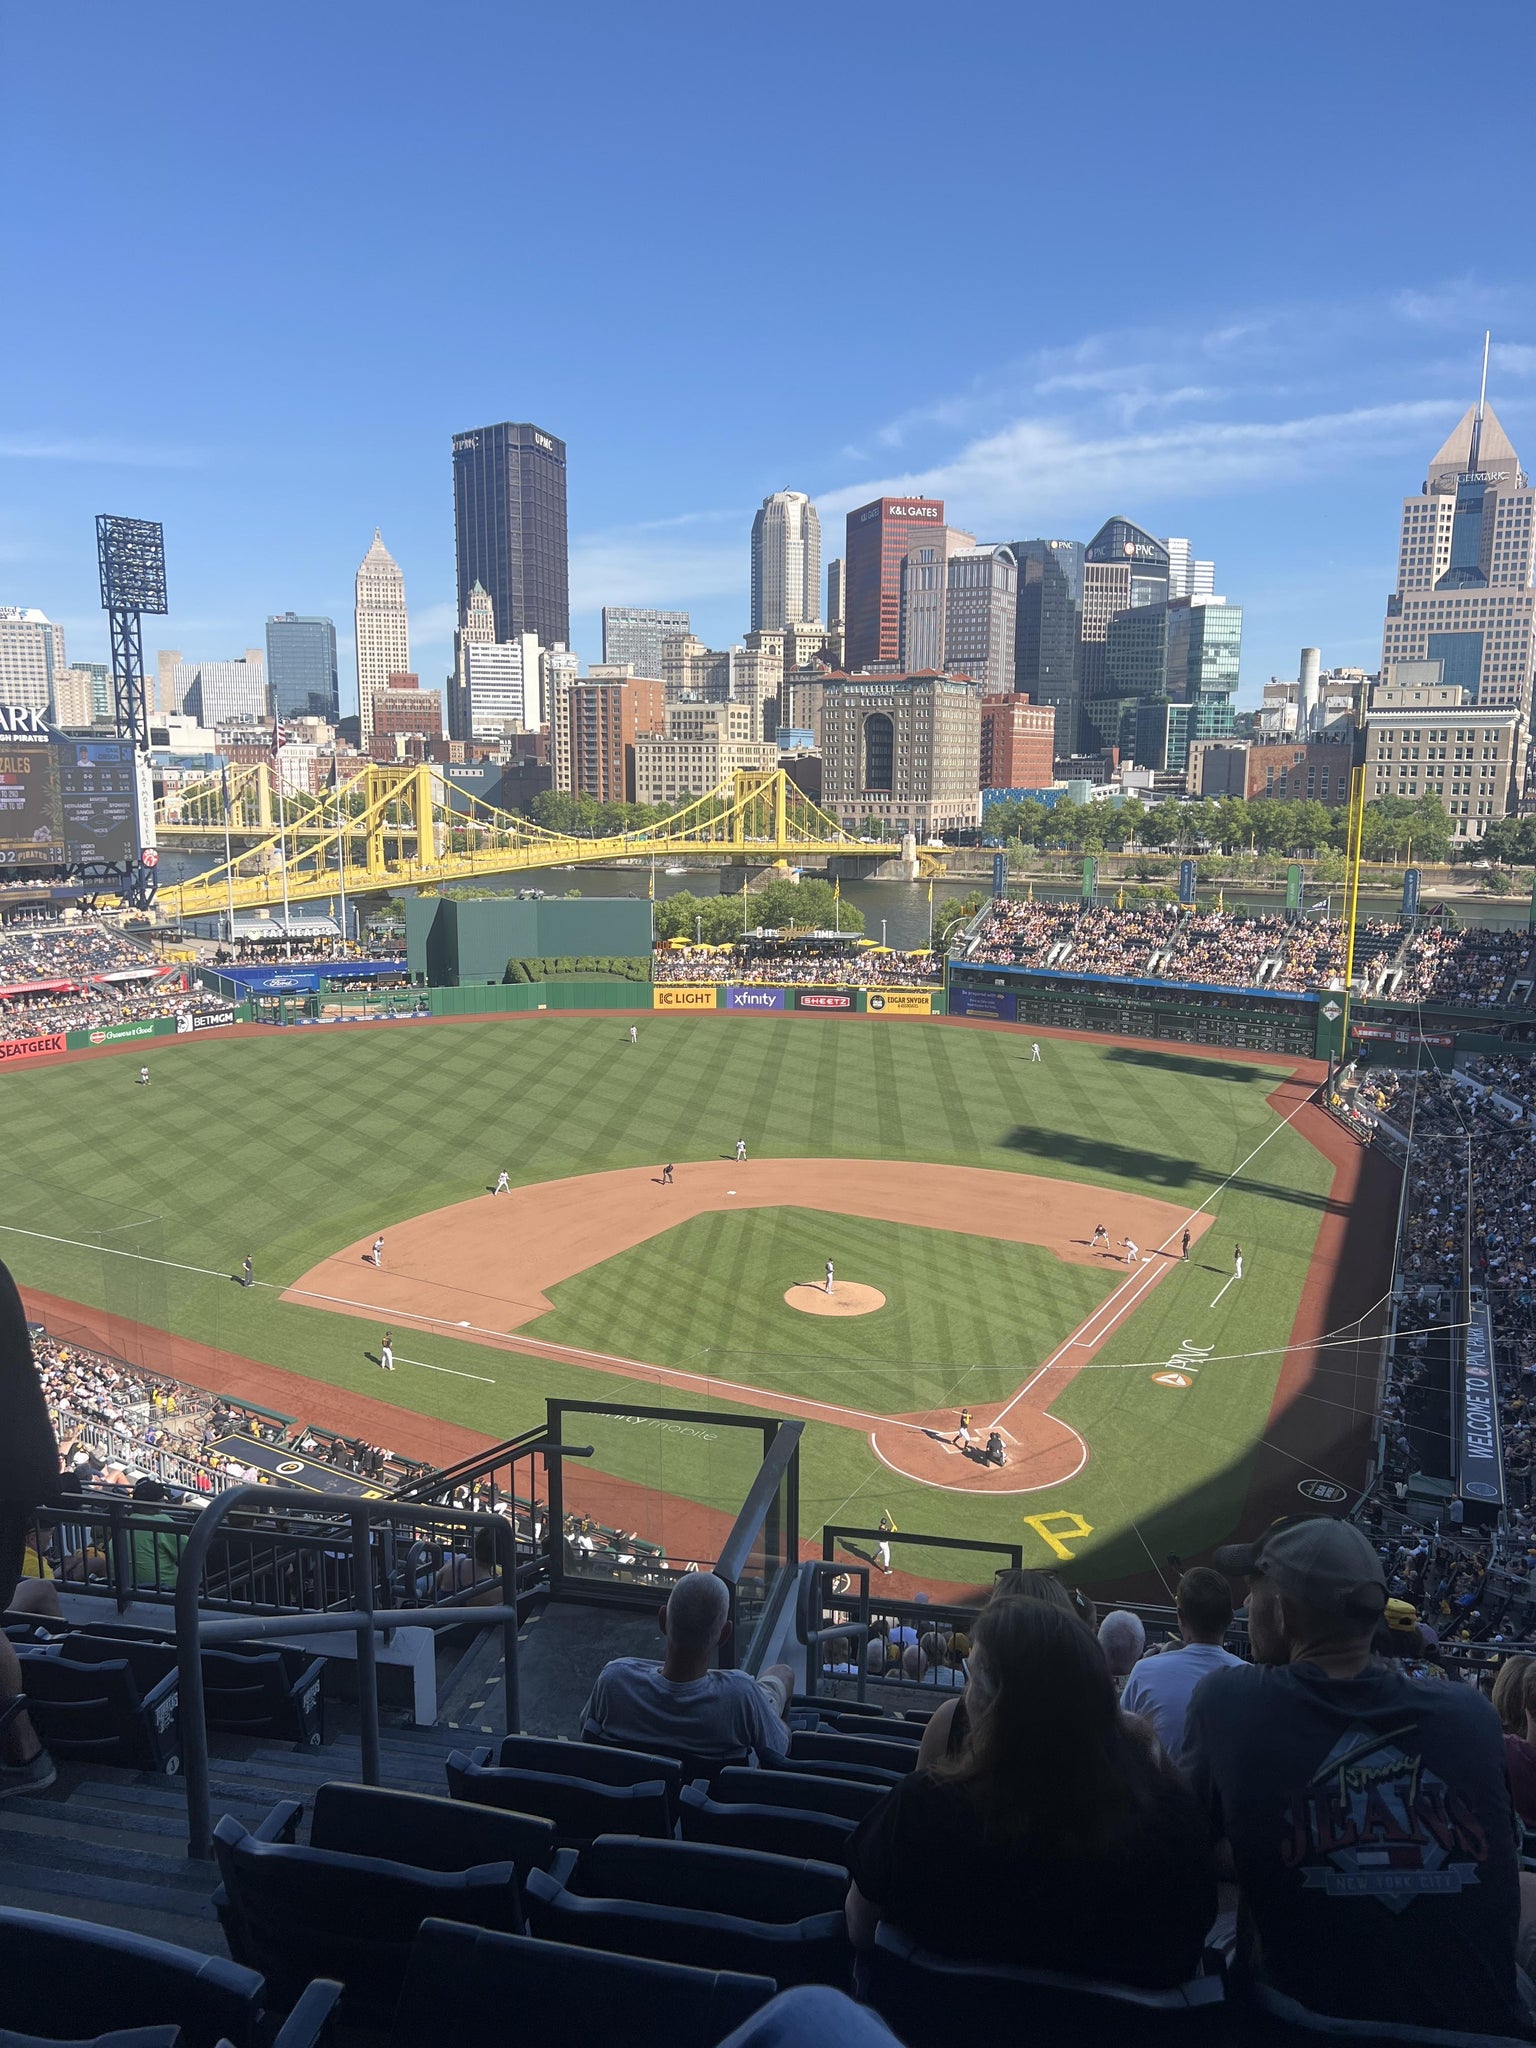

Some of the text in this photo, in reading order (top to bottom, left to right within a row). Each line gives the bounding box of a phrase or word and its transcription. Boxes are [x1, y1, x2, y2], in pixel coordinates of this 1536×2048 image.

[535, 432, 553, 451] UPMC
[888, 506, 938, 518] K&L GATES
[1058, 541, 1074, 550] PNC
[1135, 544, 1156, 556] PNC
[14, 734, 49, 743] PIRATES
[17, 850, 48, 861] PIRATES
[263, 928, 333, 939] FAT HEAD'S
[814, 930, 834, 939] TIME
[659, 992, 712, 1005] IC LIGHT
[734, 991, 777, 1007] xfinity
[804, 997, 847, 1006] SHEETZ
[887, 996, 905, 1004] EDGAR
[193, 1011, 234, 1027] BETMGM
[1176, 1010, 1297, 1028] AMERICAN LEAGUE
[135, 1024, 154, 1035] Good
[0, 1036, 62, 1060] SEATGEEK
[1164, 1339, 1215, 1372] PNC
[1465, 1327, 1494, 1459] WELCOME TO PNC PARK
[648, 1419, 718, 1441] mobile
[1023, 1509, 1095, 1561] P
[1280, 1781, 1489, 1868] JEANS
[1336, 1876, 1451, 1890] NEW YORK CITY
